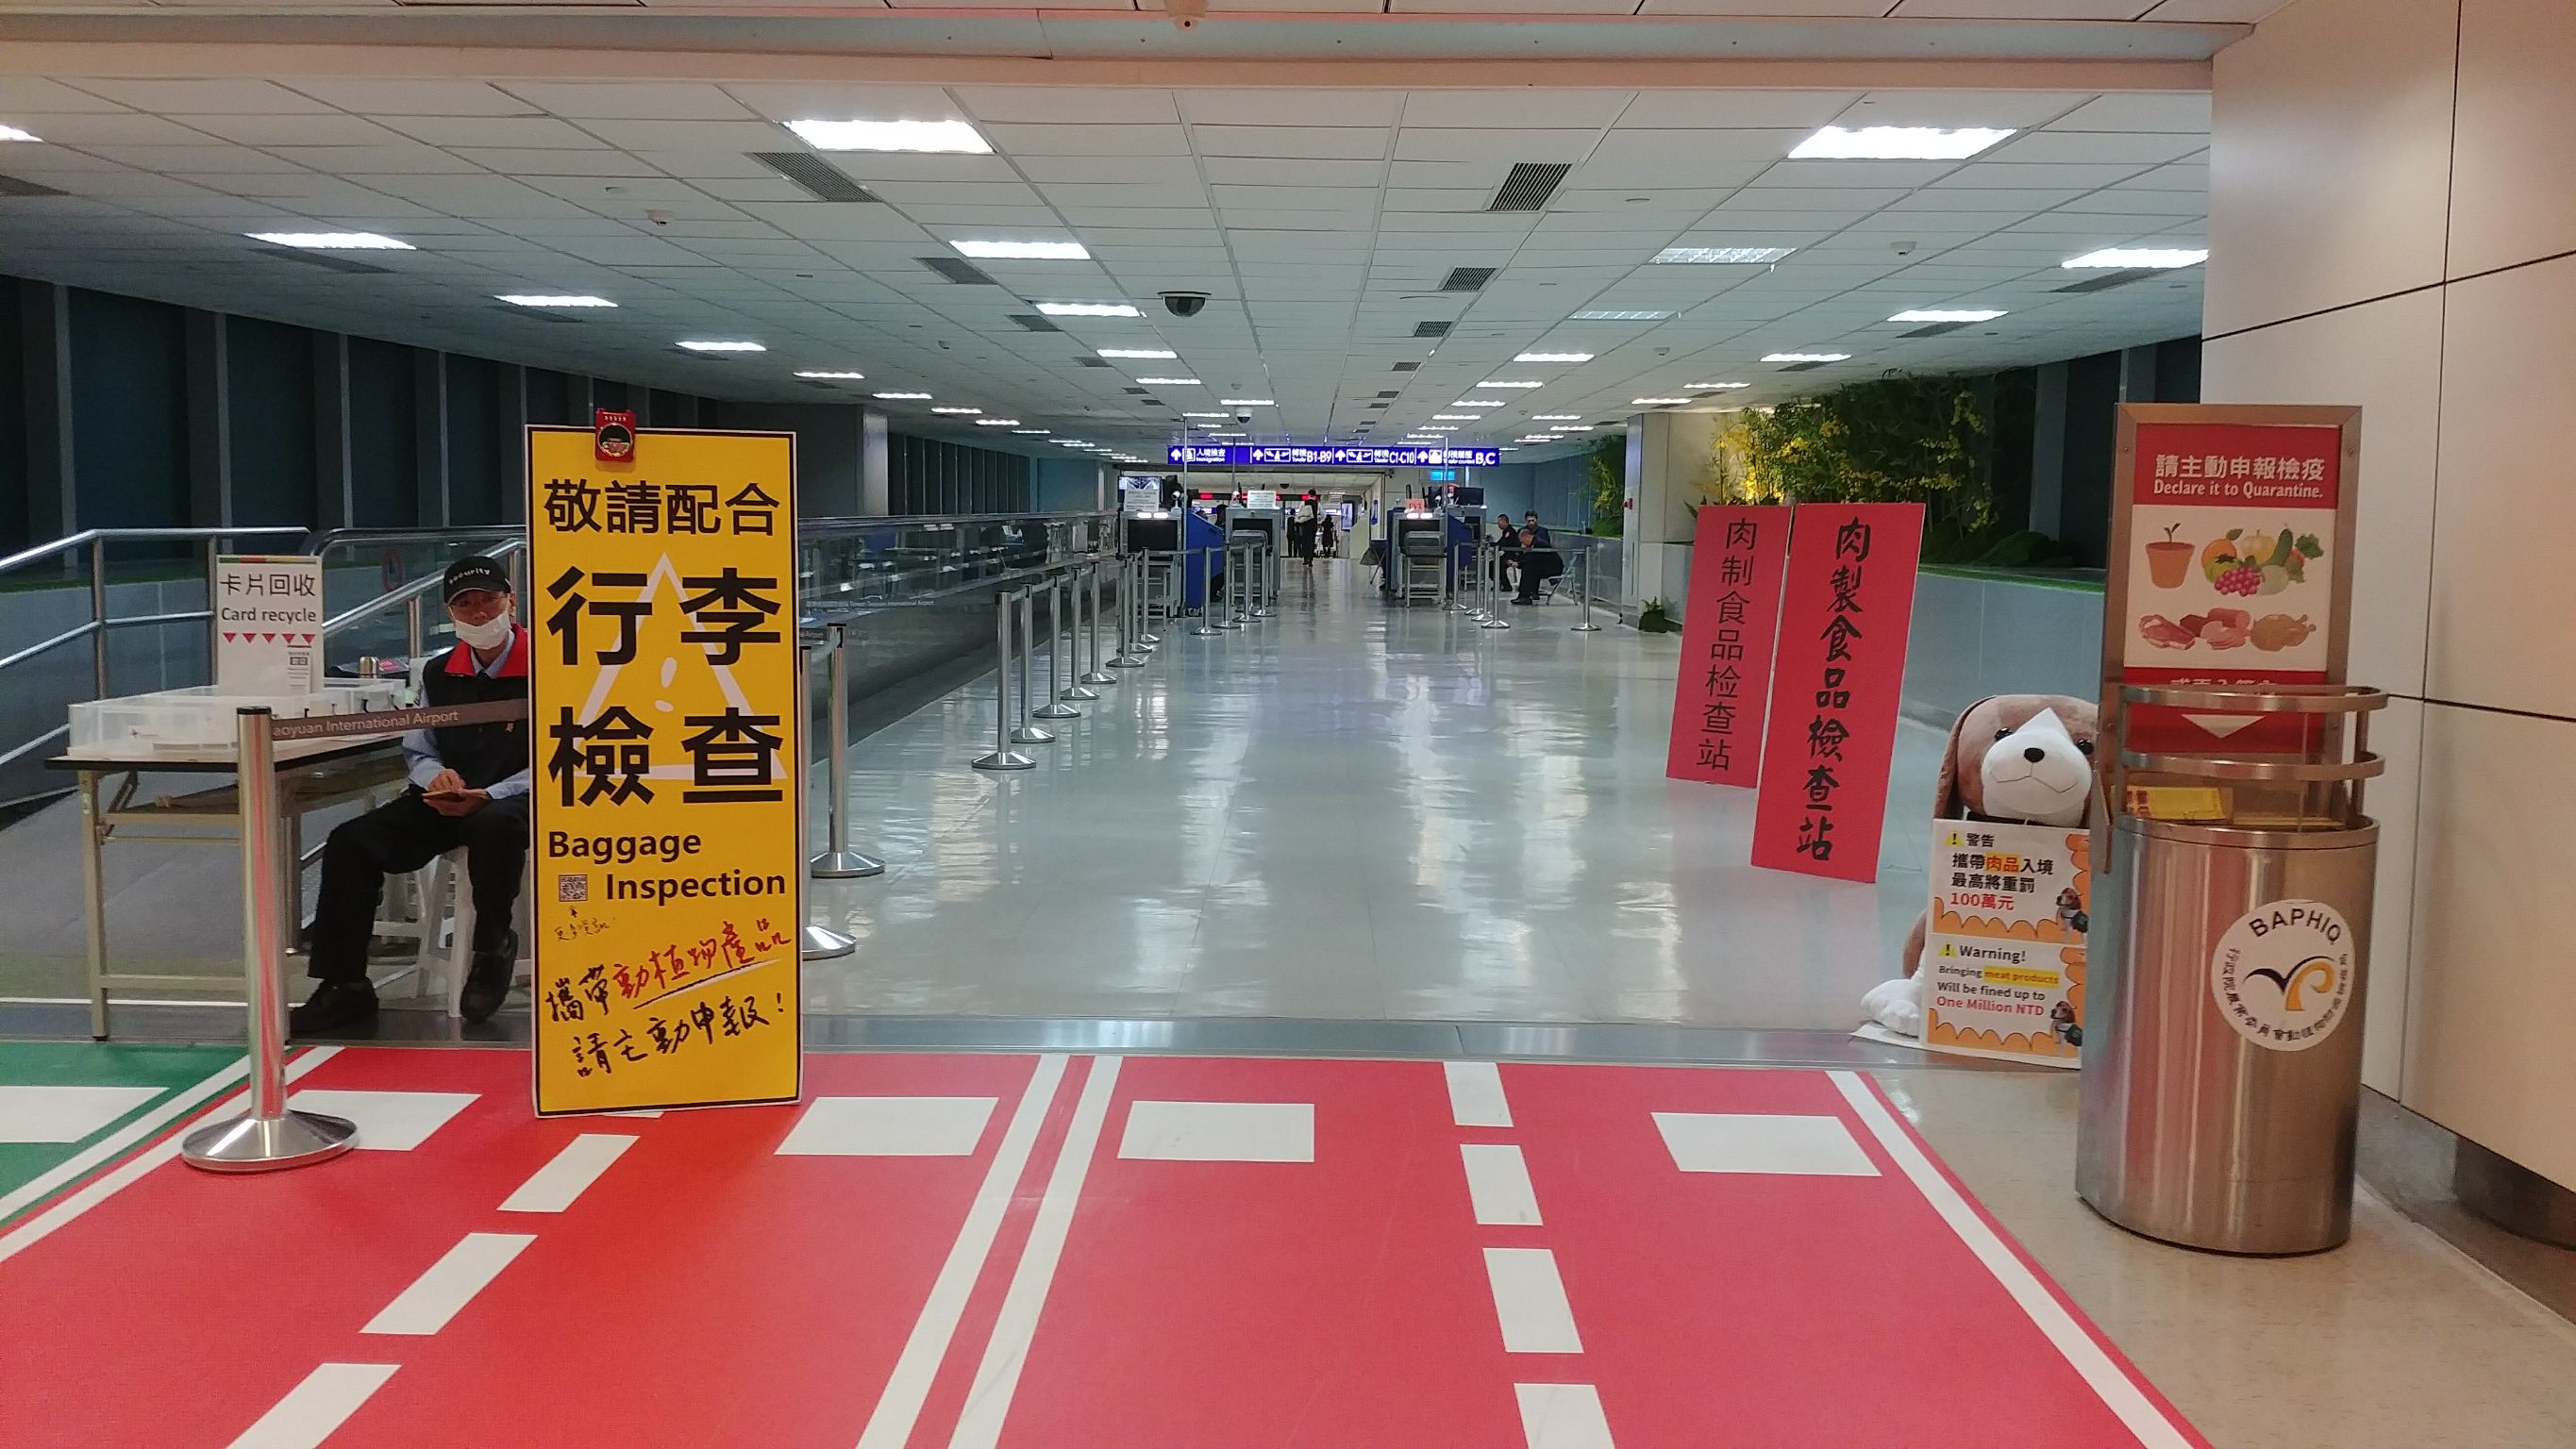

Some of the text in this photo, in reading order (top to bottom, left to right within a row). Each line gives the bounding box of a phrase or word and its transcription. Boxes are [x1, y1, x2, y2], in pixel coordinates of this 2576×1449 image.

[1307, 451, 1332, 463] B1-B9
[1389, 452, 1414, 464] C1-C10
[2155, 454, 2325, 481] 請主動申報檢疫
[2153, 478, 2323, 498] Declare it to Quarantine.
[544, 478, 779, 536] 敬請配合
[220, 574, 315, 596] 卡片回收
[222, 607, 316, 625] Card recycle
[546, 566, 781, 665] 行李
[1696, 517, 1758, 771] 肉制食品检查站
[1796, 516, 1872, 861] 肉製食品檢查站
[273, 710, 459, 738] aoyuan International Airport
[547, 707, 784, 807] 檢查
[549, 831, 701, 864] Baggage
[1965, 832, 1995, 848] 警告
[1952, 852, 2054, 875] 攜帶肉品入境
[607, 869, 785, 906] Inspection
[1951, 872, 2035, 893] 最高將重罰
[1950, 892, 2015, 911] 100萬元
[2249, 908, 2342, 945] BAPHIQ
[1959, 945, 2026, 964] Warning!
[1939, 965, 2059, 985] Bringing meat products
[1937, 981, 2046, 1001] Will be fined up to
[1936, 995, 2045, 1016] One Million NTD
